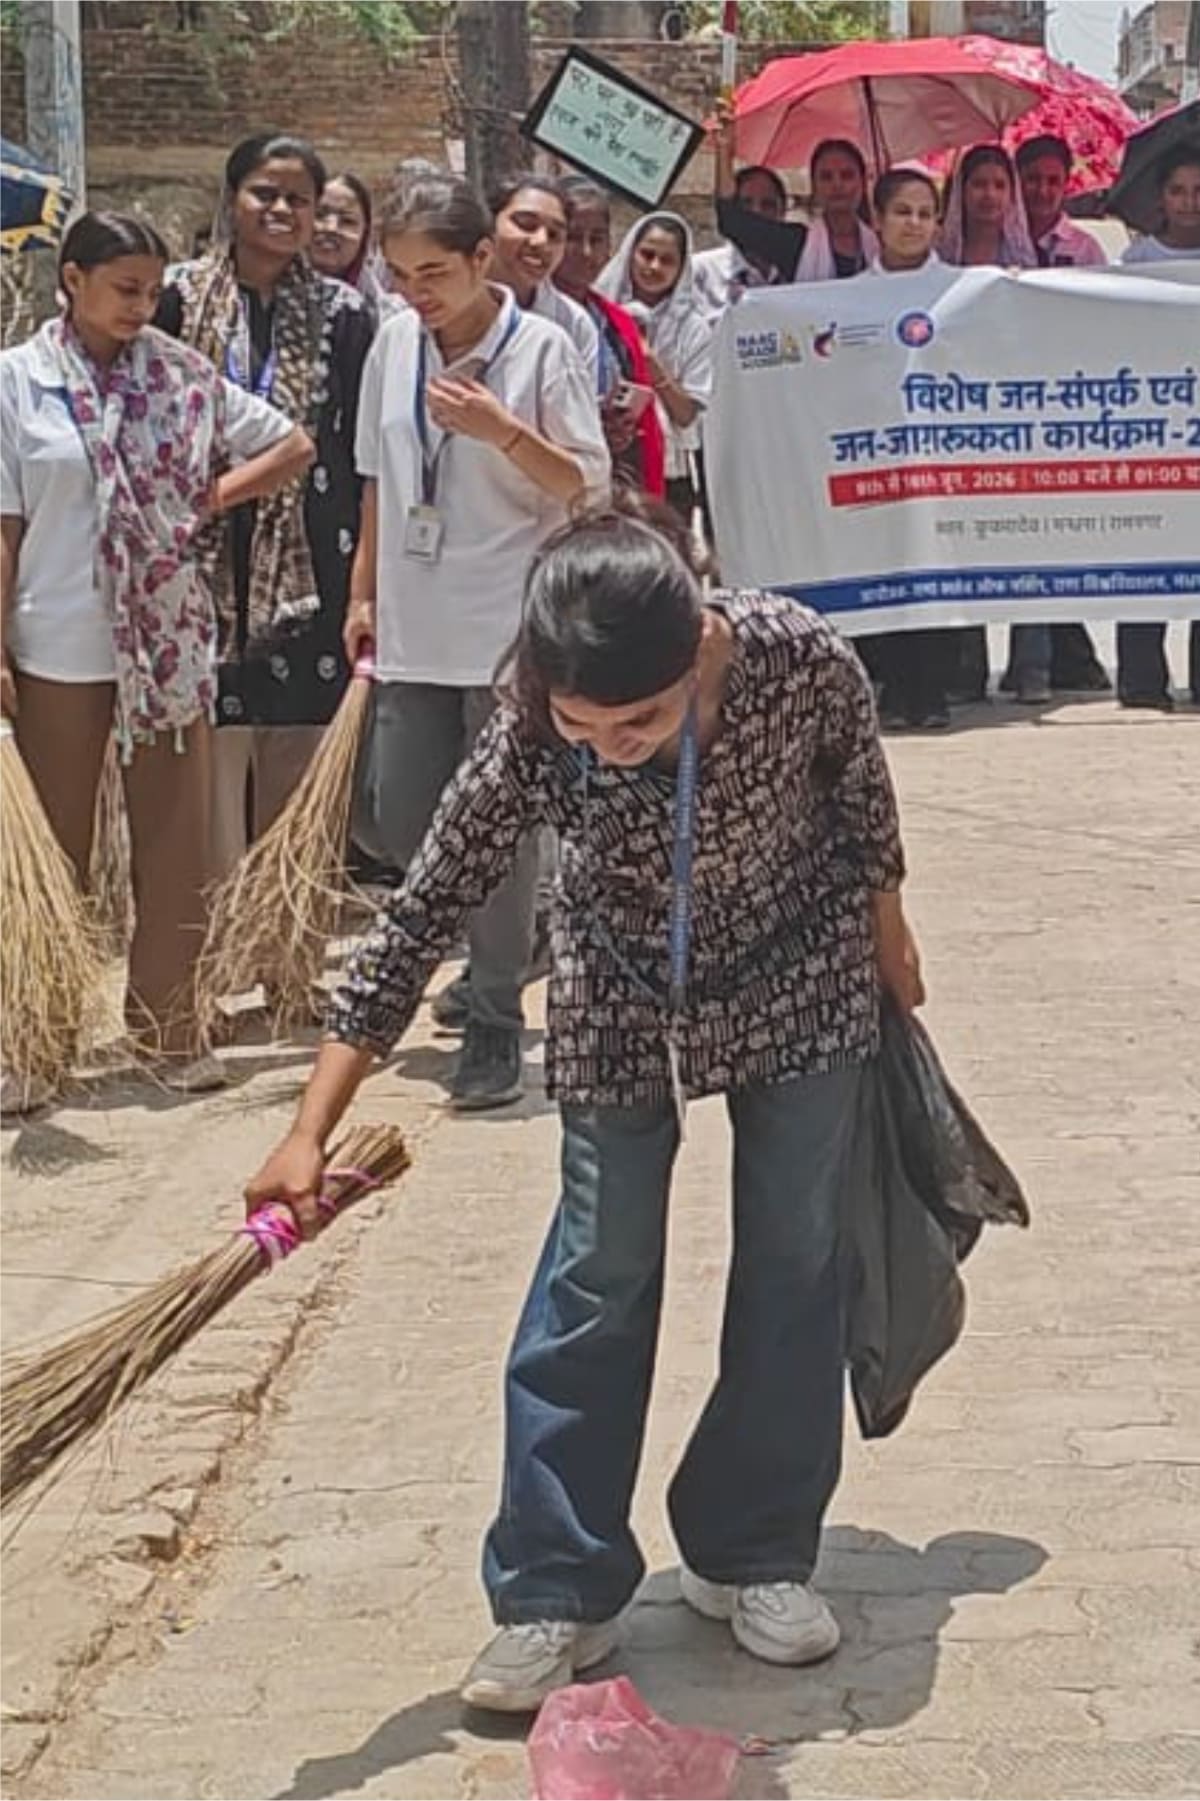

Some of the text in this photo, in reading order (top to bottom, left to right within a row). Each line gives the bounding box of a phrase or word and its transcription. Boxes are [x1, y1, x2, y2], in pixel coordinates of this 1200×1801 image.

[737, 333, 777, 347] NAAC
[902, 365, 1197, 413] विशेष जन-संपर्क एवं
[973, 471, 1016, 488] 2026
[1034, 470, 1079, 486] 10:00
[1084, 465, 1110, 486] बजे
[1115, 463, 1131, 484] से
